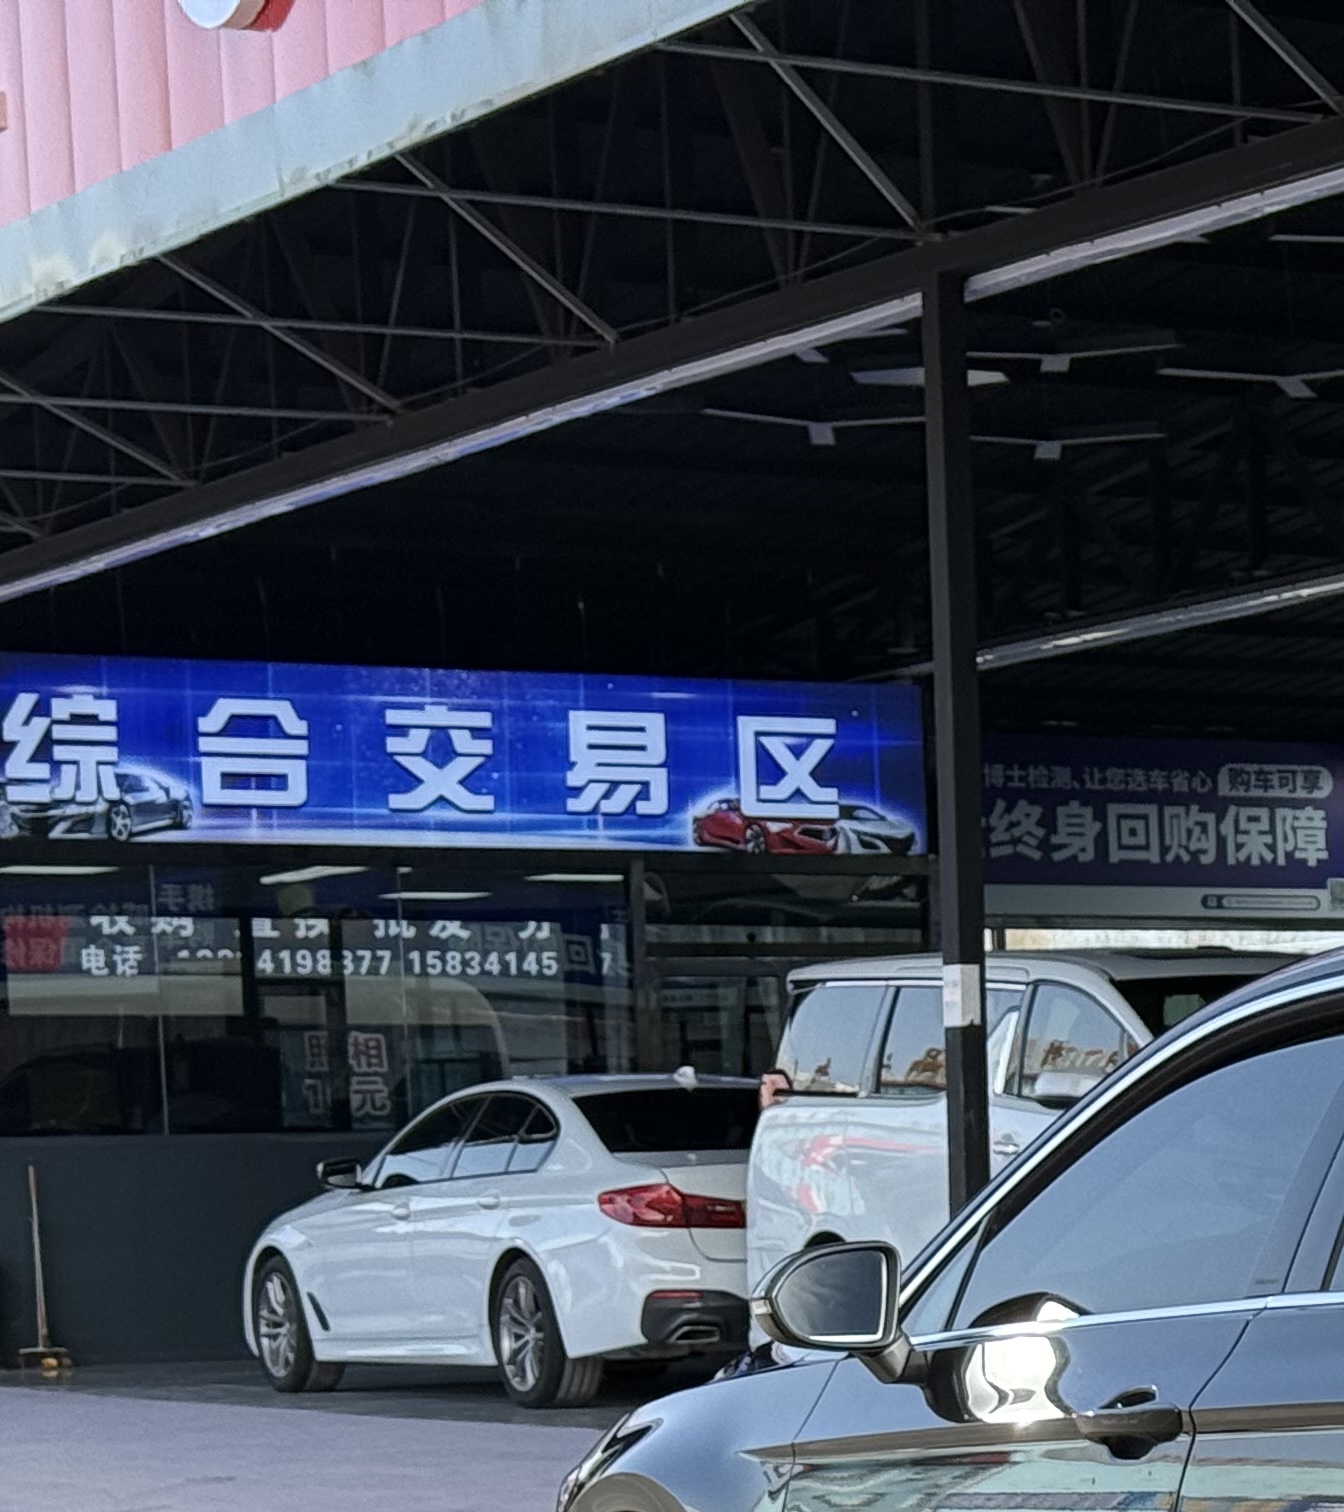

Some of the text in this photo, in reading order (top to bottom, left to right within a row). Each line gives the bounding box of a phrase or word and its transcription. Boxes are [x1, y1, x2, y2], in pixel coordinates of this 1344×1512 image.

[2, 692, 843, 819] 综合交易区
[1227, 767, 1327, 795] 购车可享
[80, 944, 146, 978] 电话
